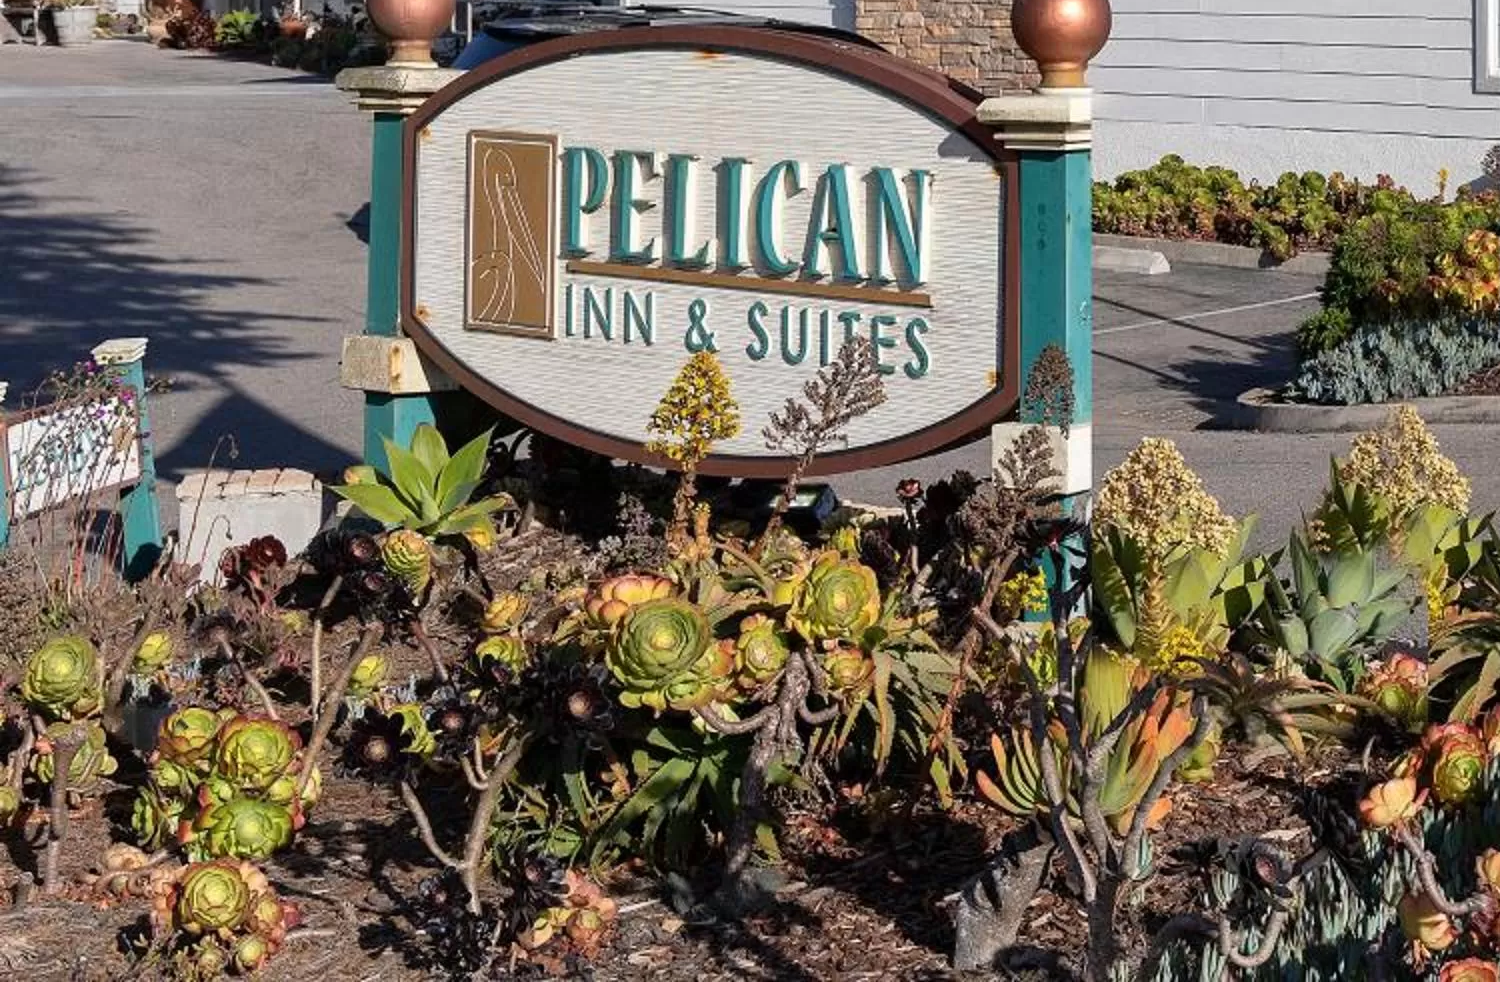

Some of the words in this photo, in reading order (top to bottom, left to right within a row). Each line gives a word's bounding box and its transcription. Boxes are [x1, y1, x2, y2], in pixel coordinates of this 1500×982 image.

[560, 145, 935, 290] PELICAN
[564, 282, 657, 346] INN
[684, 297, 719, 355] &
[745, 299, 931, 380] SUITES
